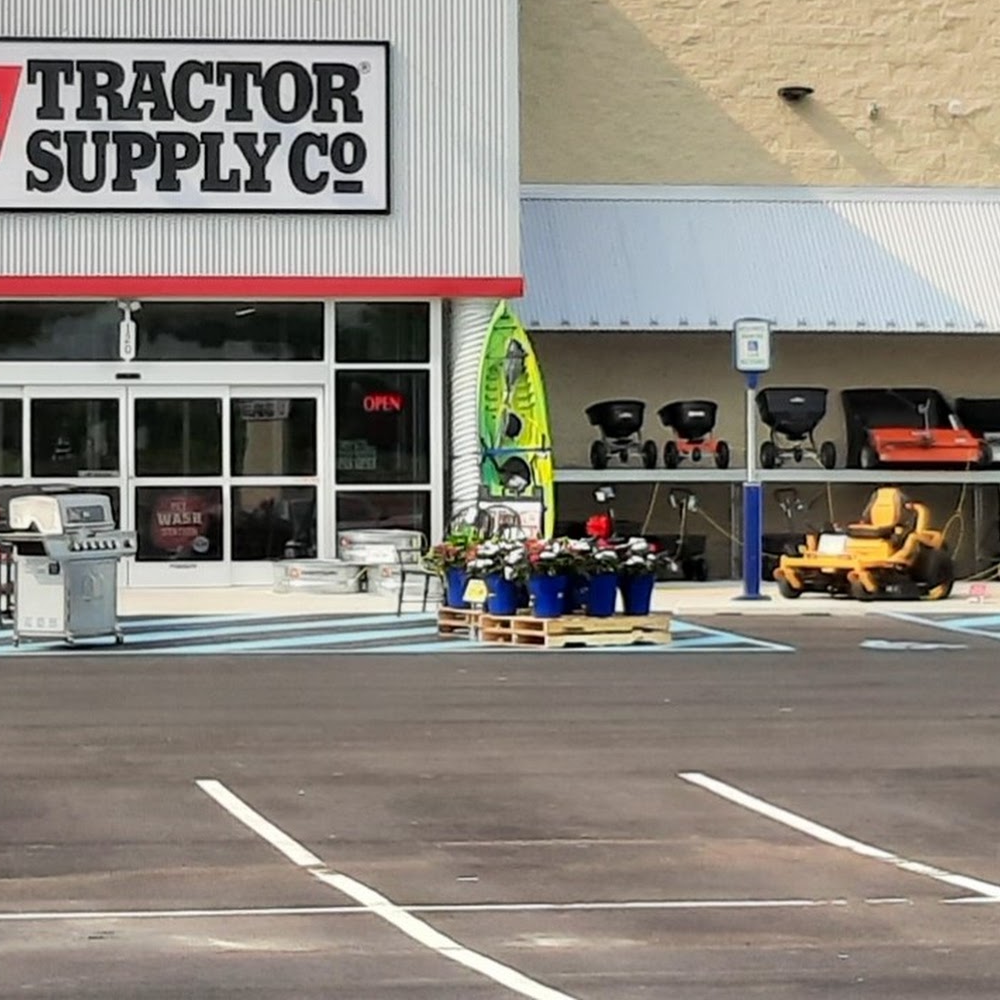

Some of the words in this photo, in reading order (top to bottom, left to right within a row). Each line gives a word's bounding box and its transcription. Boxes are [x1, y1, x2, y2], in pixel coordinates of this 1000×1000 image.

[26, 59, 363, 123] TRACTOR
[26, 130, 281, 193] SUPPLY
[363, 396, 401, 412] OPEN
[156, 511, 202, 526] WASH
